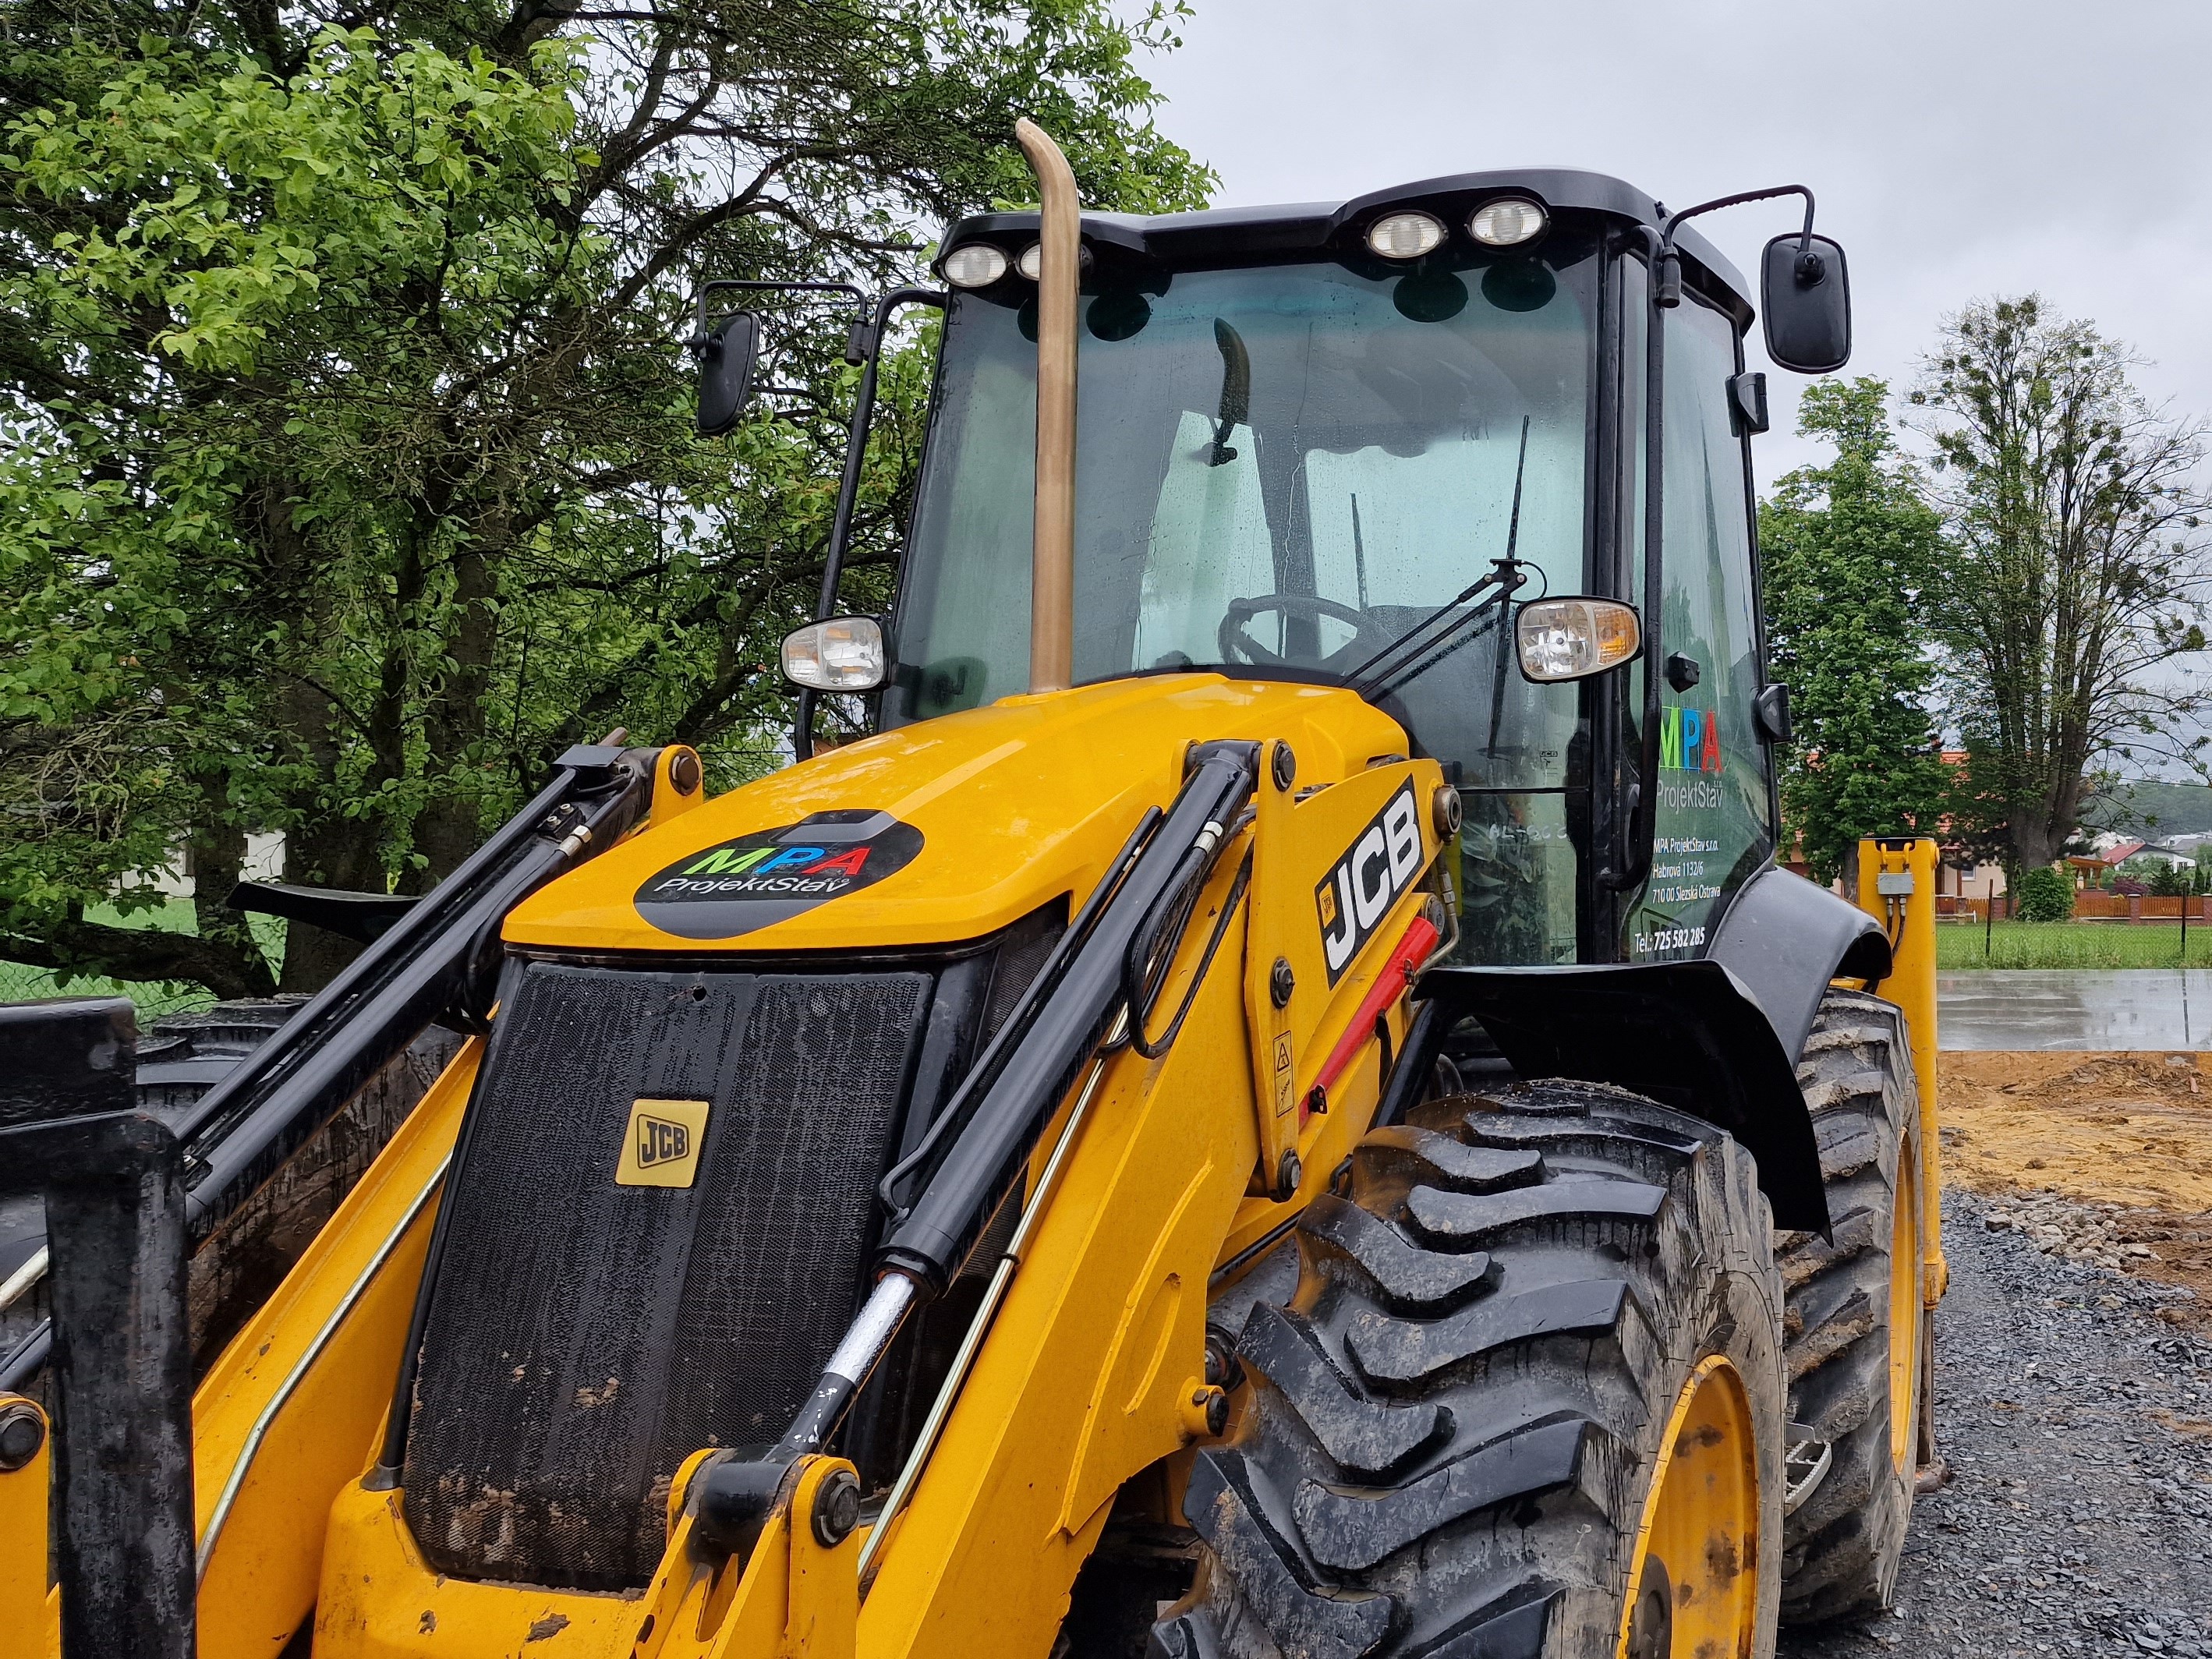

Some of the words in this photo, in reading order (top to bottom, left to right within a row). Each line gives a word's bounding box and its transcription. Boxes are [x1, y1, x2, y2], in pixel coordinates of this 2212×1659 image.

[1660, 707, 1722, 772] MPA
[1657, 780, 1723, 815] ProjektStav
[1654, 838, 1669, 854] MPA
[1670, 837, 1705, 857] ProjektStav
[681, 847, 872, 876] MPA
[1653, 861, 1681, 879] Habrová
[1683, 861, 1704, 876] 1132/6
[653, 877, 851, 894] ProjektStav
[1326, 790, 1421, 971] JCB
[1653, 889, 1665, 904] 710
[1666, 887, 1675, 902] 00
[1676, 885, 1698, 902] Slezská
[1699, 884, 1721, 899] Ostrava
[1635, 931, 1653, 953] Tel.:
[1654, 930, 1672, 951] 725
[1672, 929, 1689, 949] 582
[1690, 926, 1705, 946] 285
[642, 1120, 685, 1163] JCB
